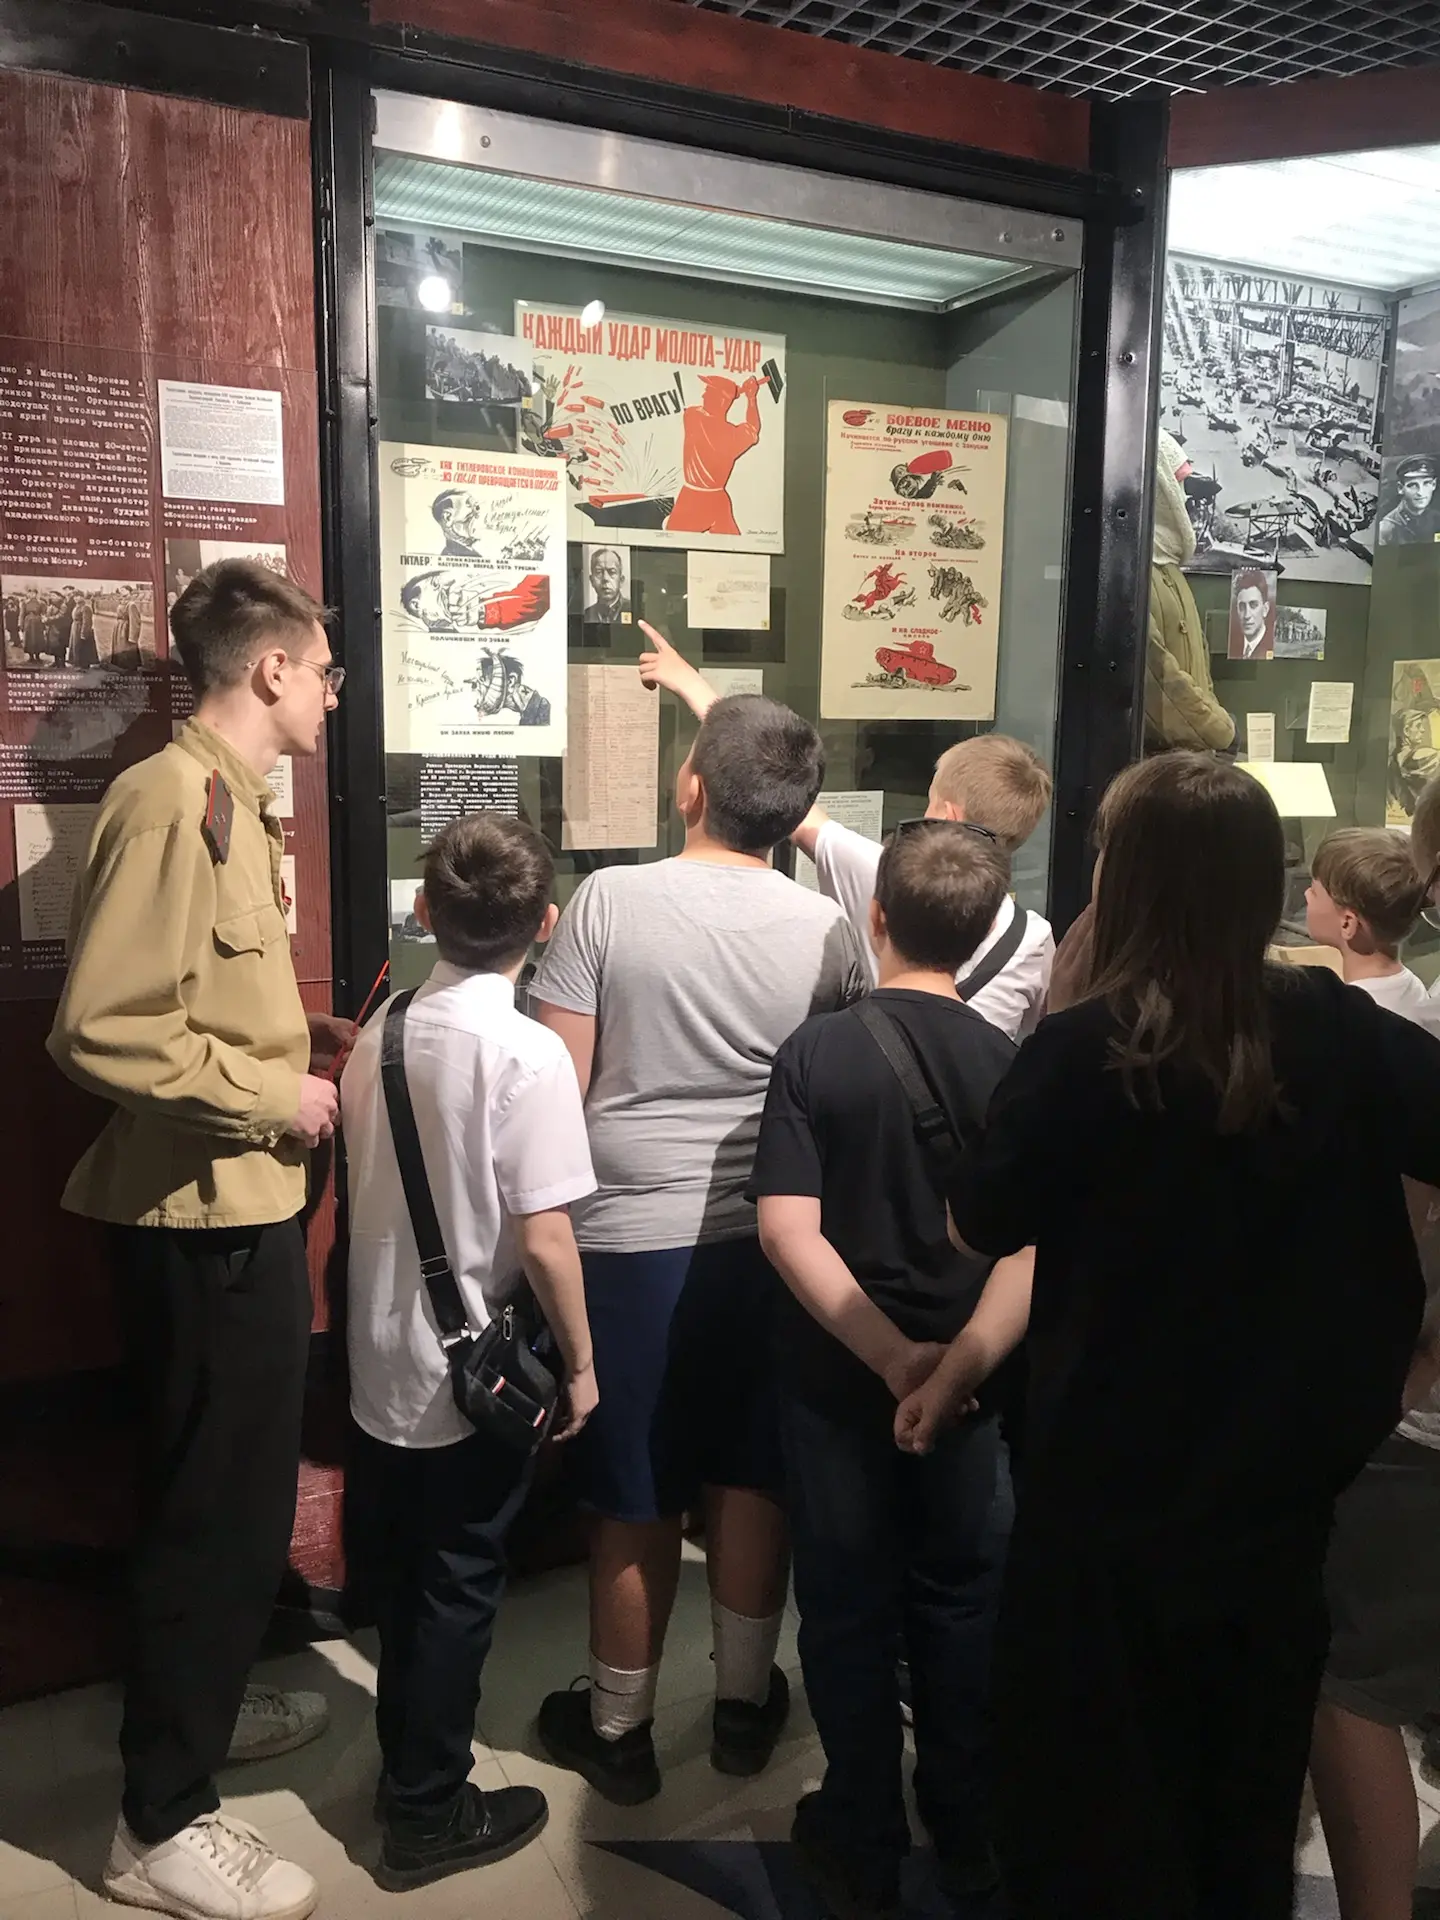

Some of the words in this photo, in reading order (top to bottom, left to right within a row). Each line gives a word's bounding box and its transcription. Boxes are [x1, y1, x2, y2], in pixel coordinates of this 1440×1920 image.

[523, 313, 603, 355] КАЖДЫЙ
[608, 322, 651, 361] УДАР
[40, 369, 78, 381] Москве,
[87, 373, 129, 386] Воронеже
[17, 378, 56, 389] военные
[64, 382, 101, 394] парады.
[109, 386, 131, 397] Цель
[40, 390, 78, 402] Родины.
[610, 403, 635, 425] ПО
[632, 371, 687, 421] ВРАГУ!
[69, 407, 107, 416] столице
[19, 412, 47, 421] яркий
[53, 416, 86, 426] пример
[91, 421, 135, 430] мужества
[886, 413, 941, 430] БОЕВОЕ
[946, 417, 992, 432] МЕНЮ
[840, 432, 881, 442] Начинается
[885, 425, 913, 437] врагу
[924, 431, 969, 441] каждому
[972, 434, 992, 442] дню
[18, 434, 41, 443] утра
[62, 439, 100, 448] площади
[104, 441, 148, 452] 20-летия
[14, 445, 58, 455] принимал
[63, 448, 121, 461] командующий
[14, 455, 91, 469] Константинович
[95, 461, 148, 474] Тимошенко,
[59, 471, 148, 485] генерал-лейтенант
[22, 478, 76, 490] Оркестром
[86, 484, 149, 496] дирижировал
[0, 489, 53, 499] салитинов
[80, 494, 150, 508] капельмейстер
[873, 497, 897, 506] Затем
[61, 504, 104, 515] дивизии,
[113, 507, 149, 517] будущий
[163, 502, 195, 511] Заметка
[210, 506, 237, 514] газеты
[5, 511, 81, 523] академического
[88, 515, 150, 528] Воронежского
[185, 522, 211, 530] ноября
[6, 533, 78, 544] вооруженные
[89, 538, 152, 550] по-боевому
[26, 544, 77, 555] окончания
[135, 551, 152, 559] они
[32, 556, 49, 564] под
[51, 556, 88, 567] Москву.
